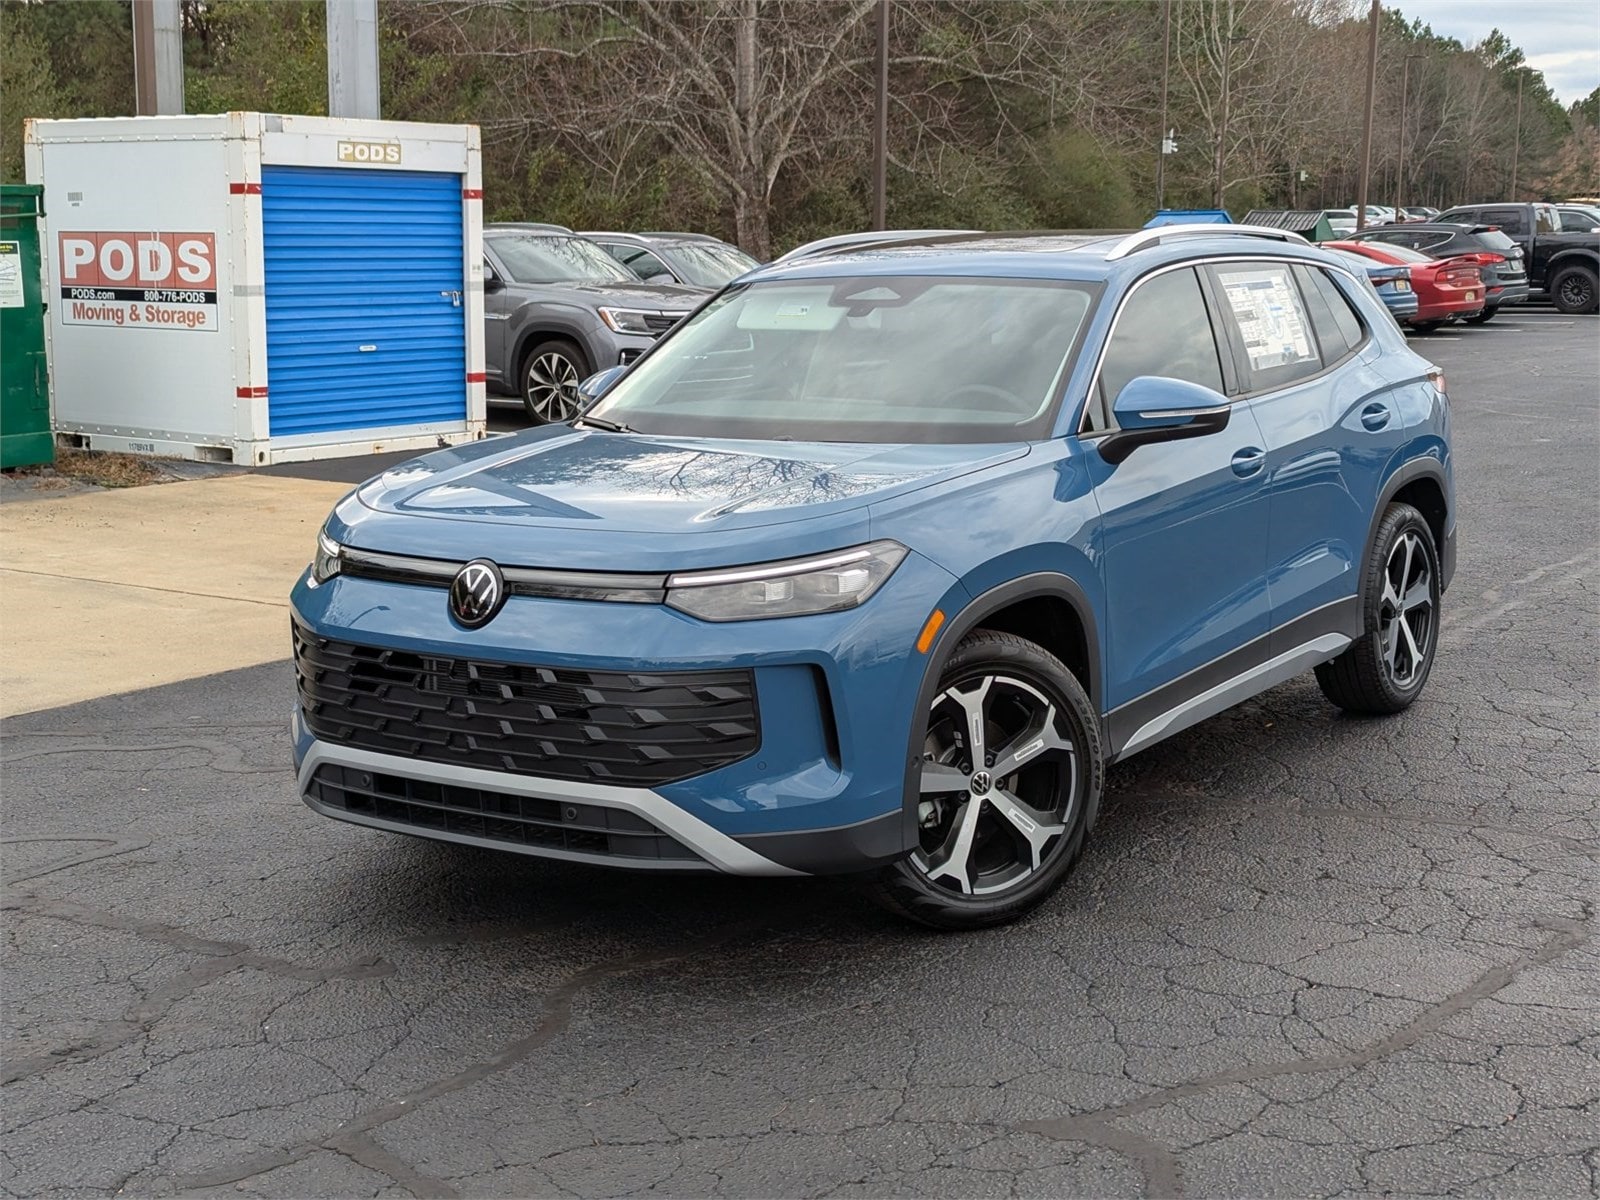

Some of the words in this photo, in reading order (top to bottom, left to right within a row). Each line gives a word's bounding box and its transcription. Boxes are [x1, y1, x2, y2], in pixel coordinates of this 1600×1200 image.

[339, 143, 400, 161] PODS
[63, 239, 211, 283] PODS
[71, 288, 115, 300] PODS.com
[144, 290, 206, 303] 800-776-PODS
[72, 302, 124, 325] Moving
[129, 304, 141, 322] &
[145, 304, 206, 328] Storage
